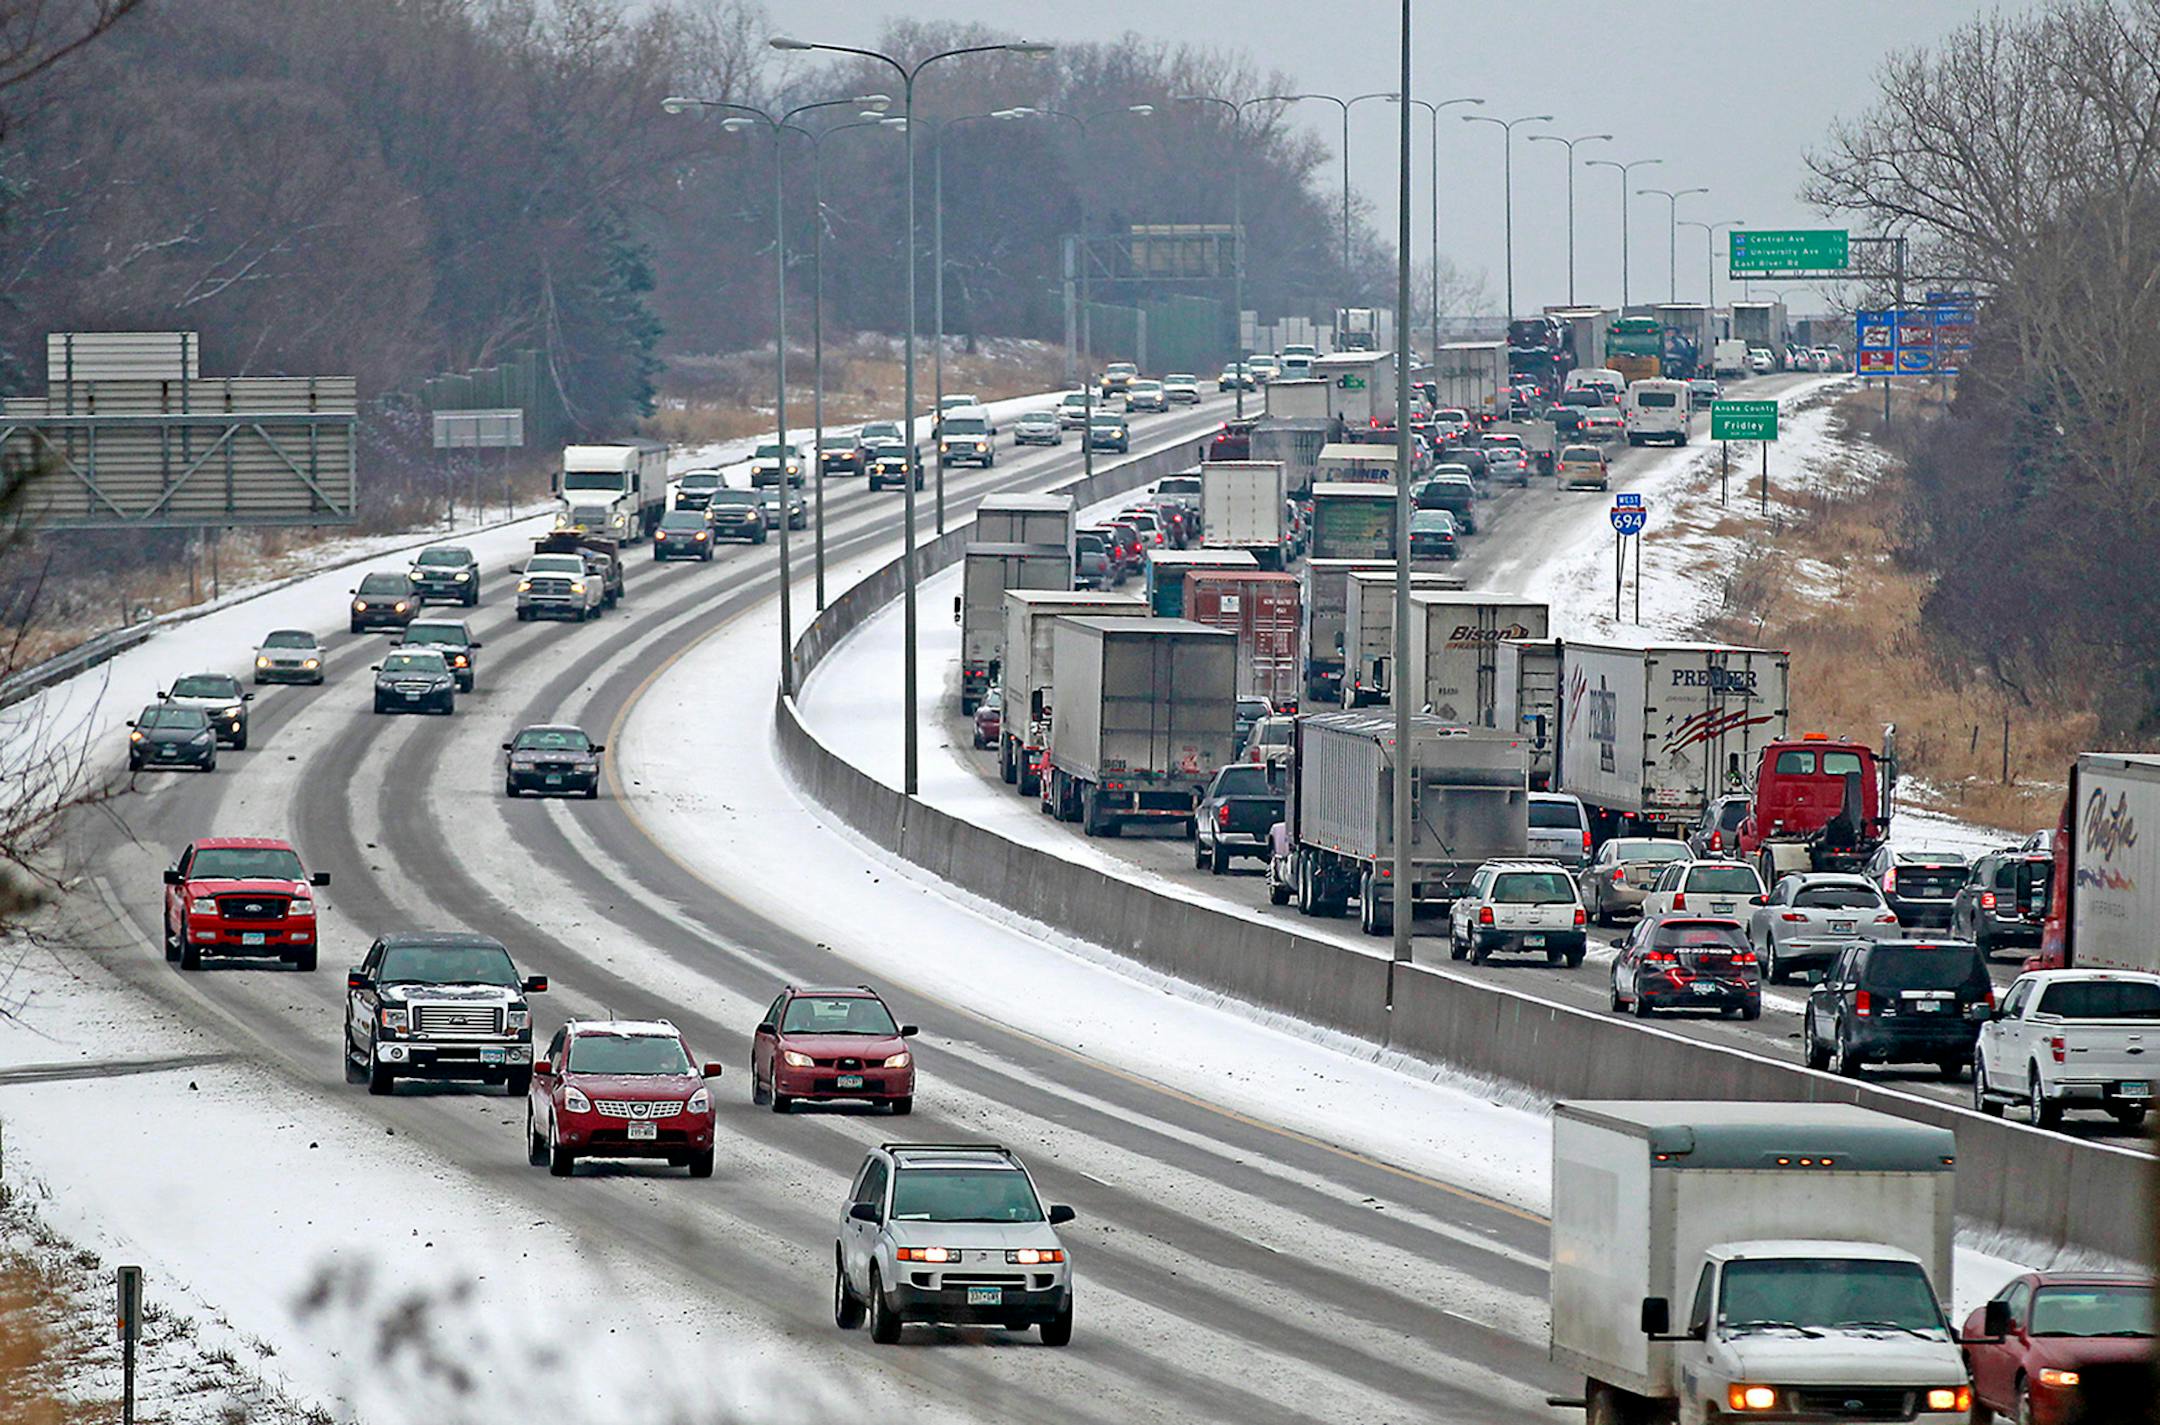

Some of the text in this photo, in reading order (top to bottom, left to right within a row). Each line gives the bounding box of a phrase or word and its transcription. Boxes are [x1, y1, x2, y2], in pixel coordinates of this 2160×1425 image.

[1750, 235, 1784, 243] Central
[1744, 404, 1774, 412] County
[1724, 421, 1764, 431] Fridley
[1619, 495, 1639, 504] WEST
[1614, 514, 1642, 529] 694
[1449, 625, 1512, 640] Bison
